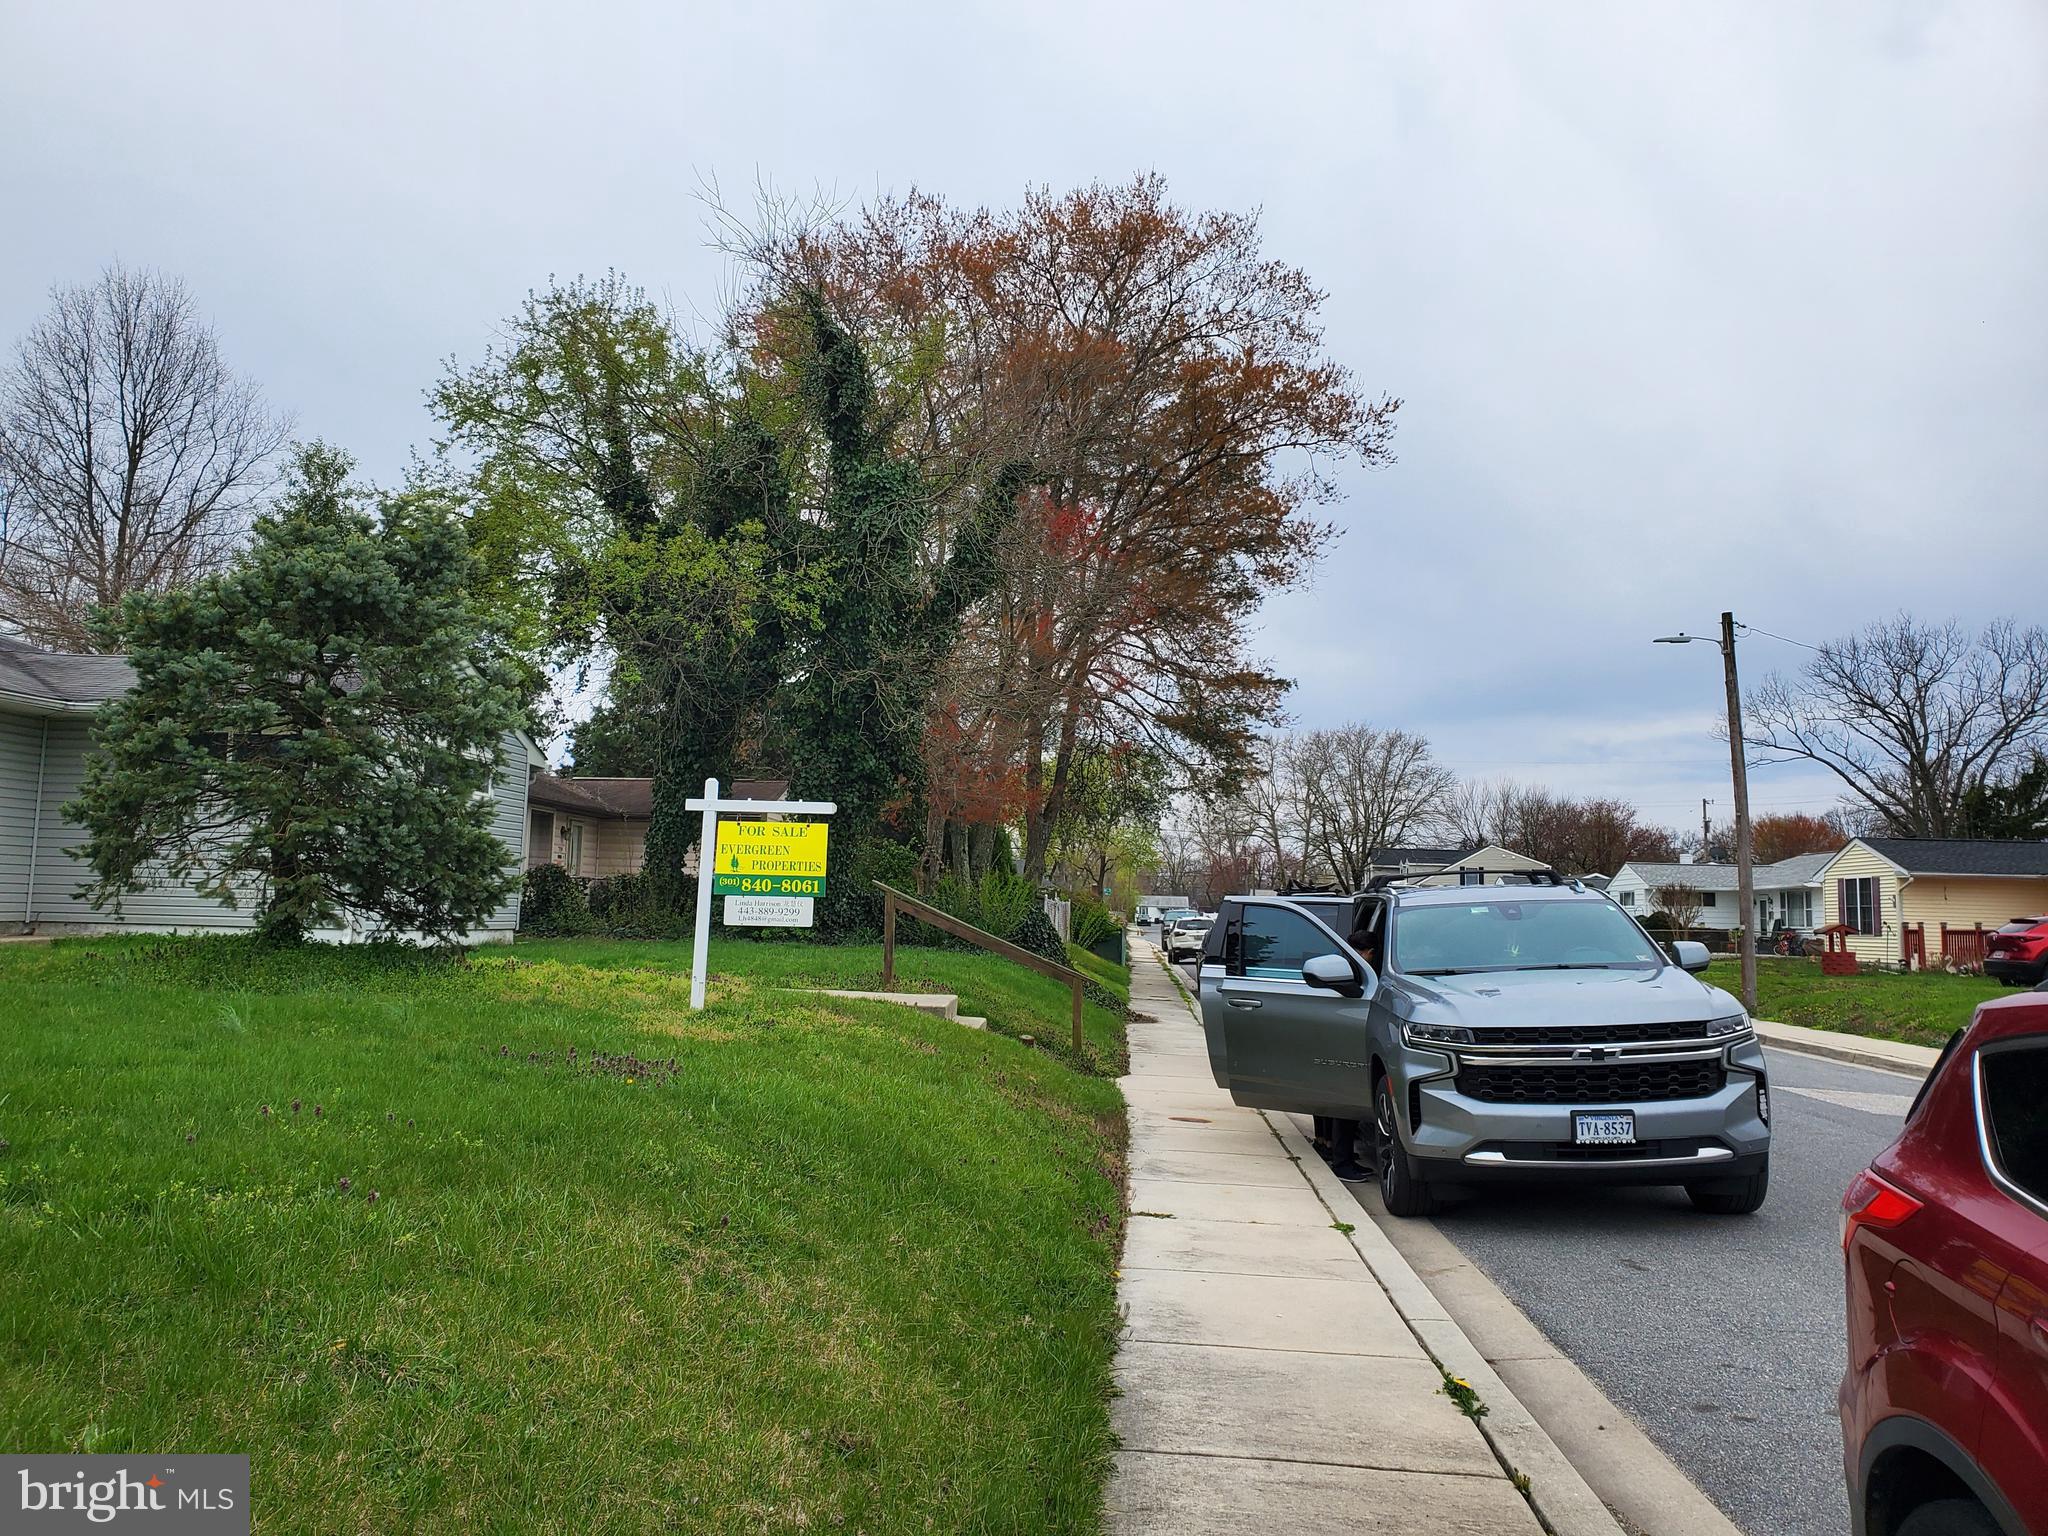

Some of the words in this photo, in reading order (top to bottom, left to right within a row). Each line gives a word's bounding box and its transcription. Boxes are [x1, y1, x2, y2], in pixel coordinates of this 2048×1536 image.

[738, 825, 766, 837] FOR
[772, 826, 808, 838] SALE
[721, 843, 791, 856] EVERGREEN
[751, 859, 822, 872] PROPERTIES
[719, 876, 740, 887] (301)
[741, 878, 820, 893] 840-8061
[737, 906, 801, 917] 443-889-9299
[1579, 1121, 1632, 1136] TVA-8537
